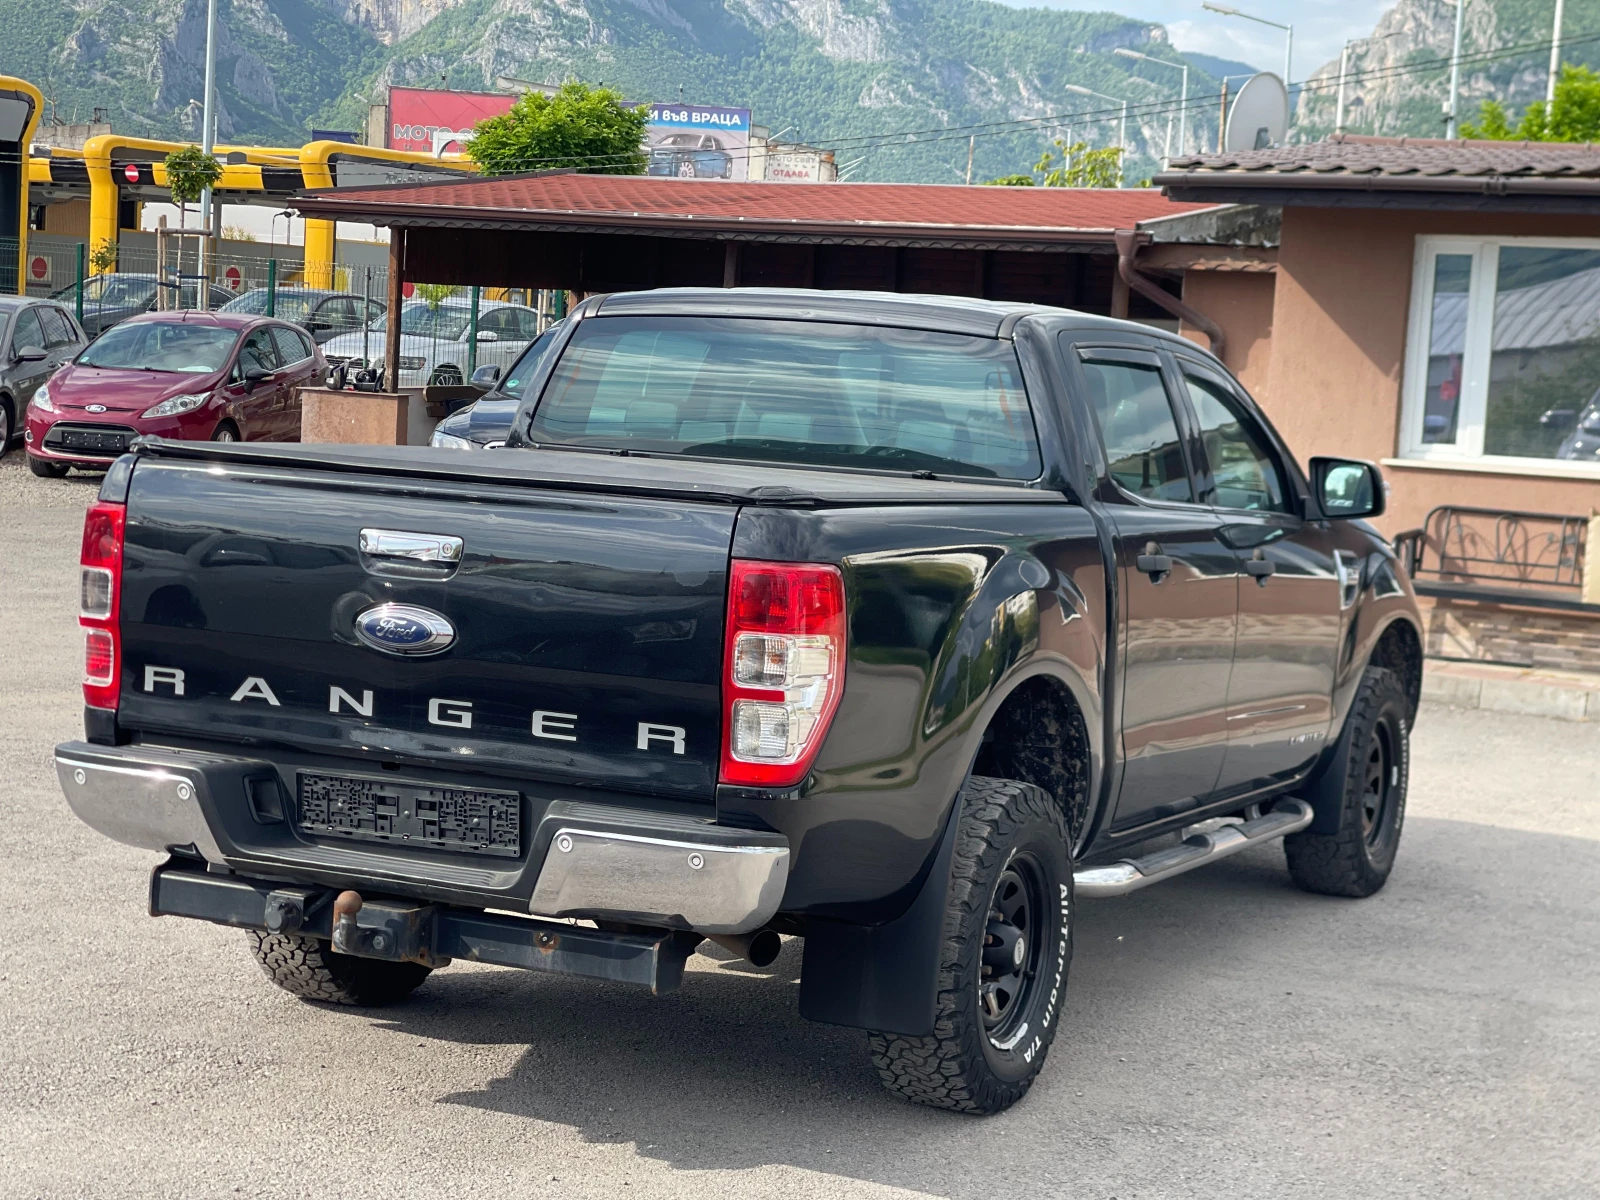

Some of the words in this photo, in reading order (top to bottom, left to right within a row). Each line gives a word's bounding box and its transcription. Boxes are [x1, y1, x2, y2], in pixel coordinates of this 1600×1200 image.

[692, 112, 741, 126] ВРАЦА
[773, 169, 809, 178] ОТДАВА
[376, 617, 417, 641] Ford
[143, 664, 687, 755] RANGER
[1042, 883, 1068, 1028] All-Terrain
[1024, 1035, 1042, 1064] T/A
